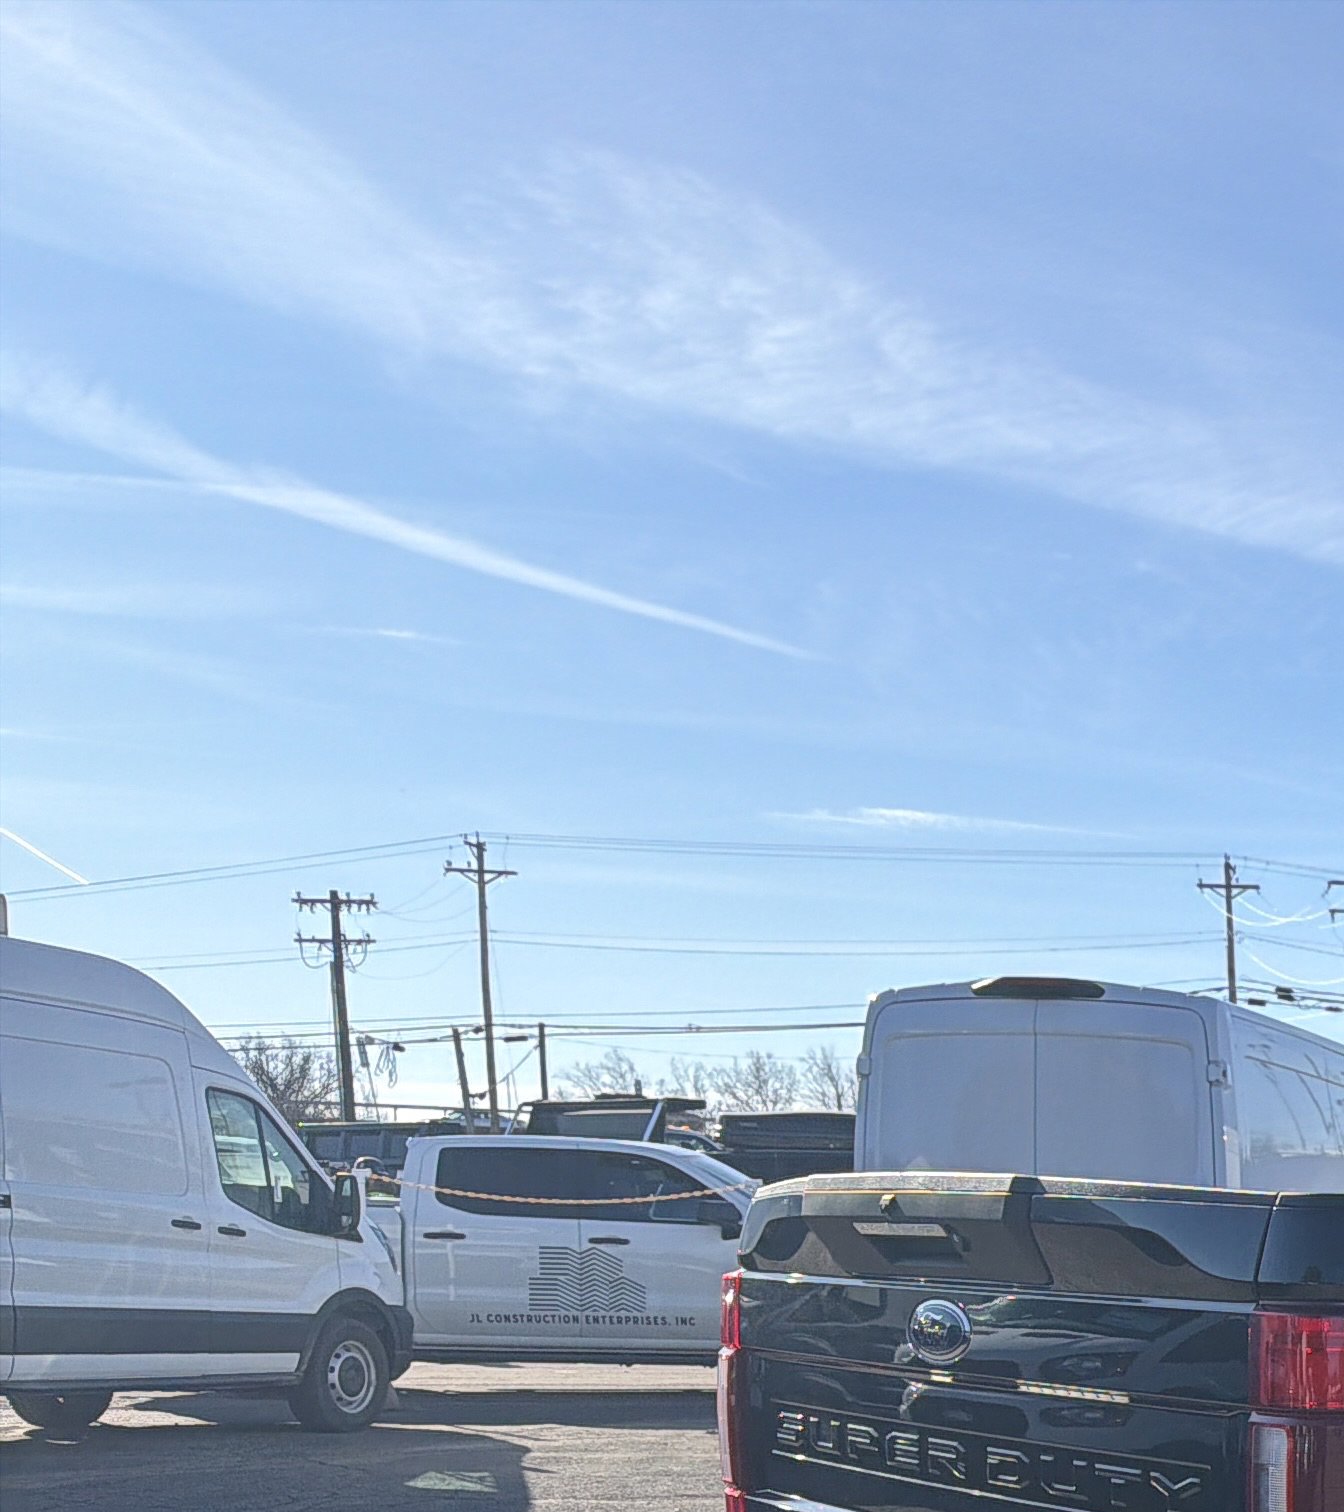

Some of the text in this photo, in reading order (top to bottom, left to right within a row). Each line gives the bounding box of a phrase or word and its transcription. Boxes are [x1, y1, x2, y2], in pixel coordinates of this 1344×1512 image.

[469, 1313, 483, 1324] JL
[486, 1313, 580, 1325] CONSTRUCTION
[675, 1316, 697, 1327] INC
[776, 1410, 967, 1480] SUPER
